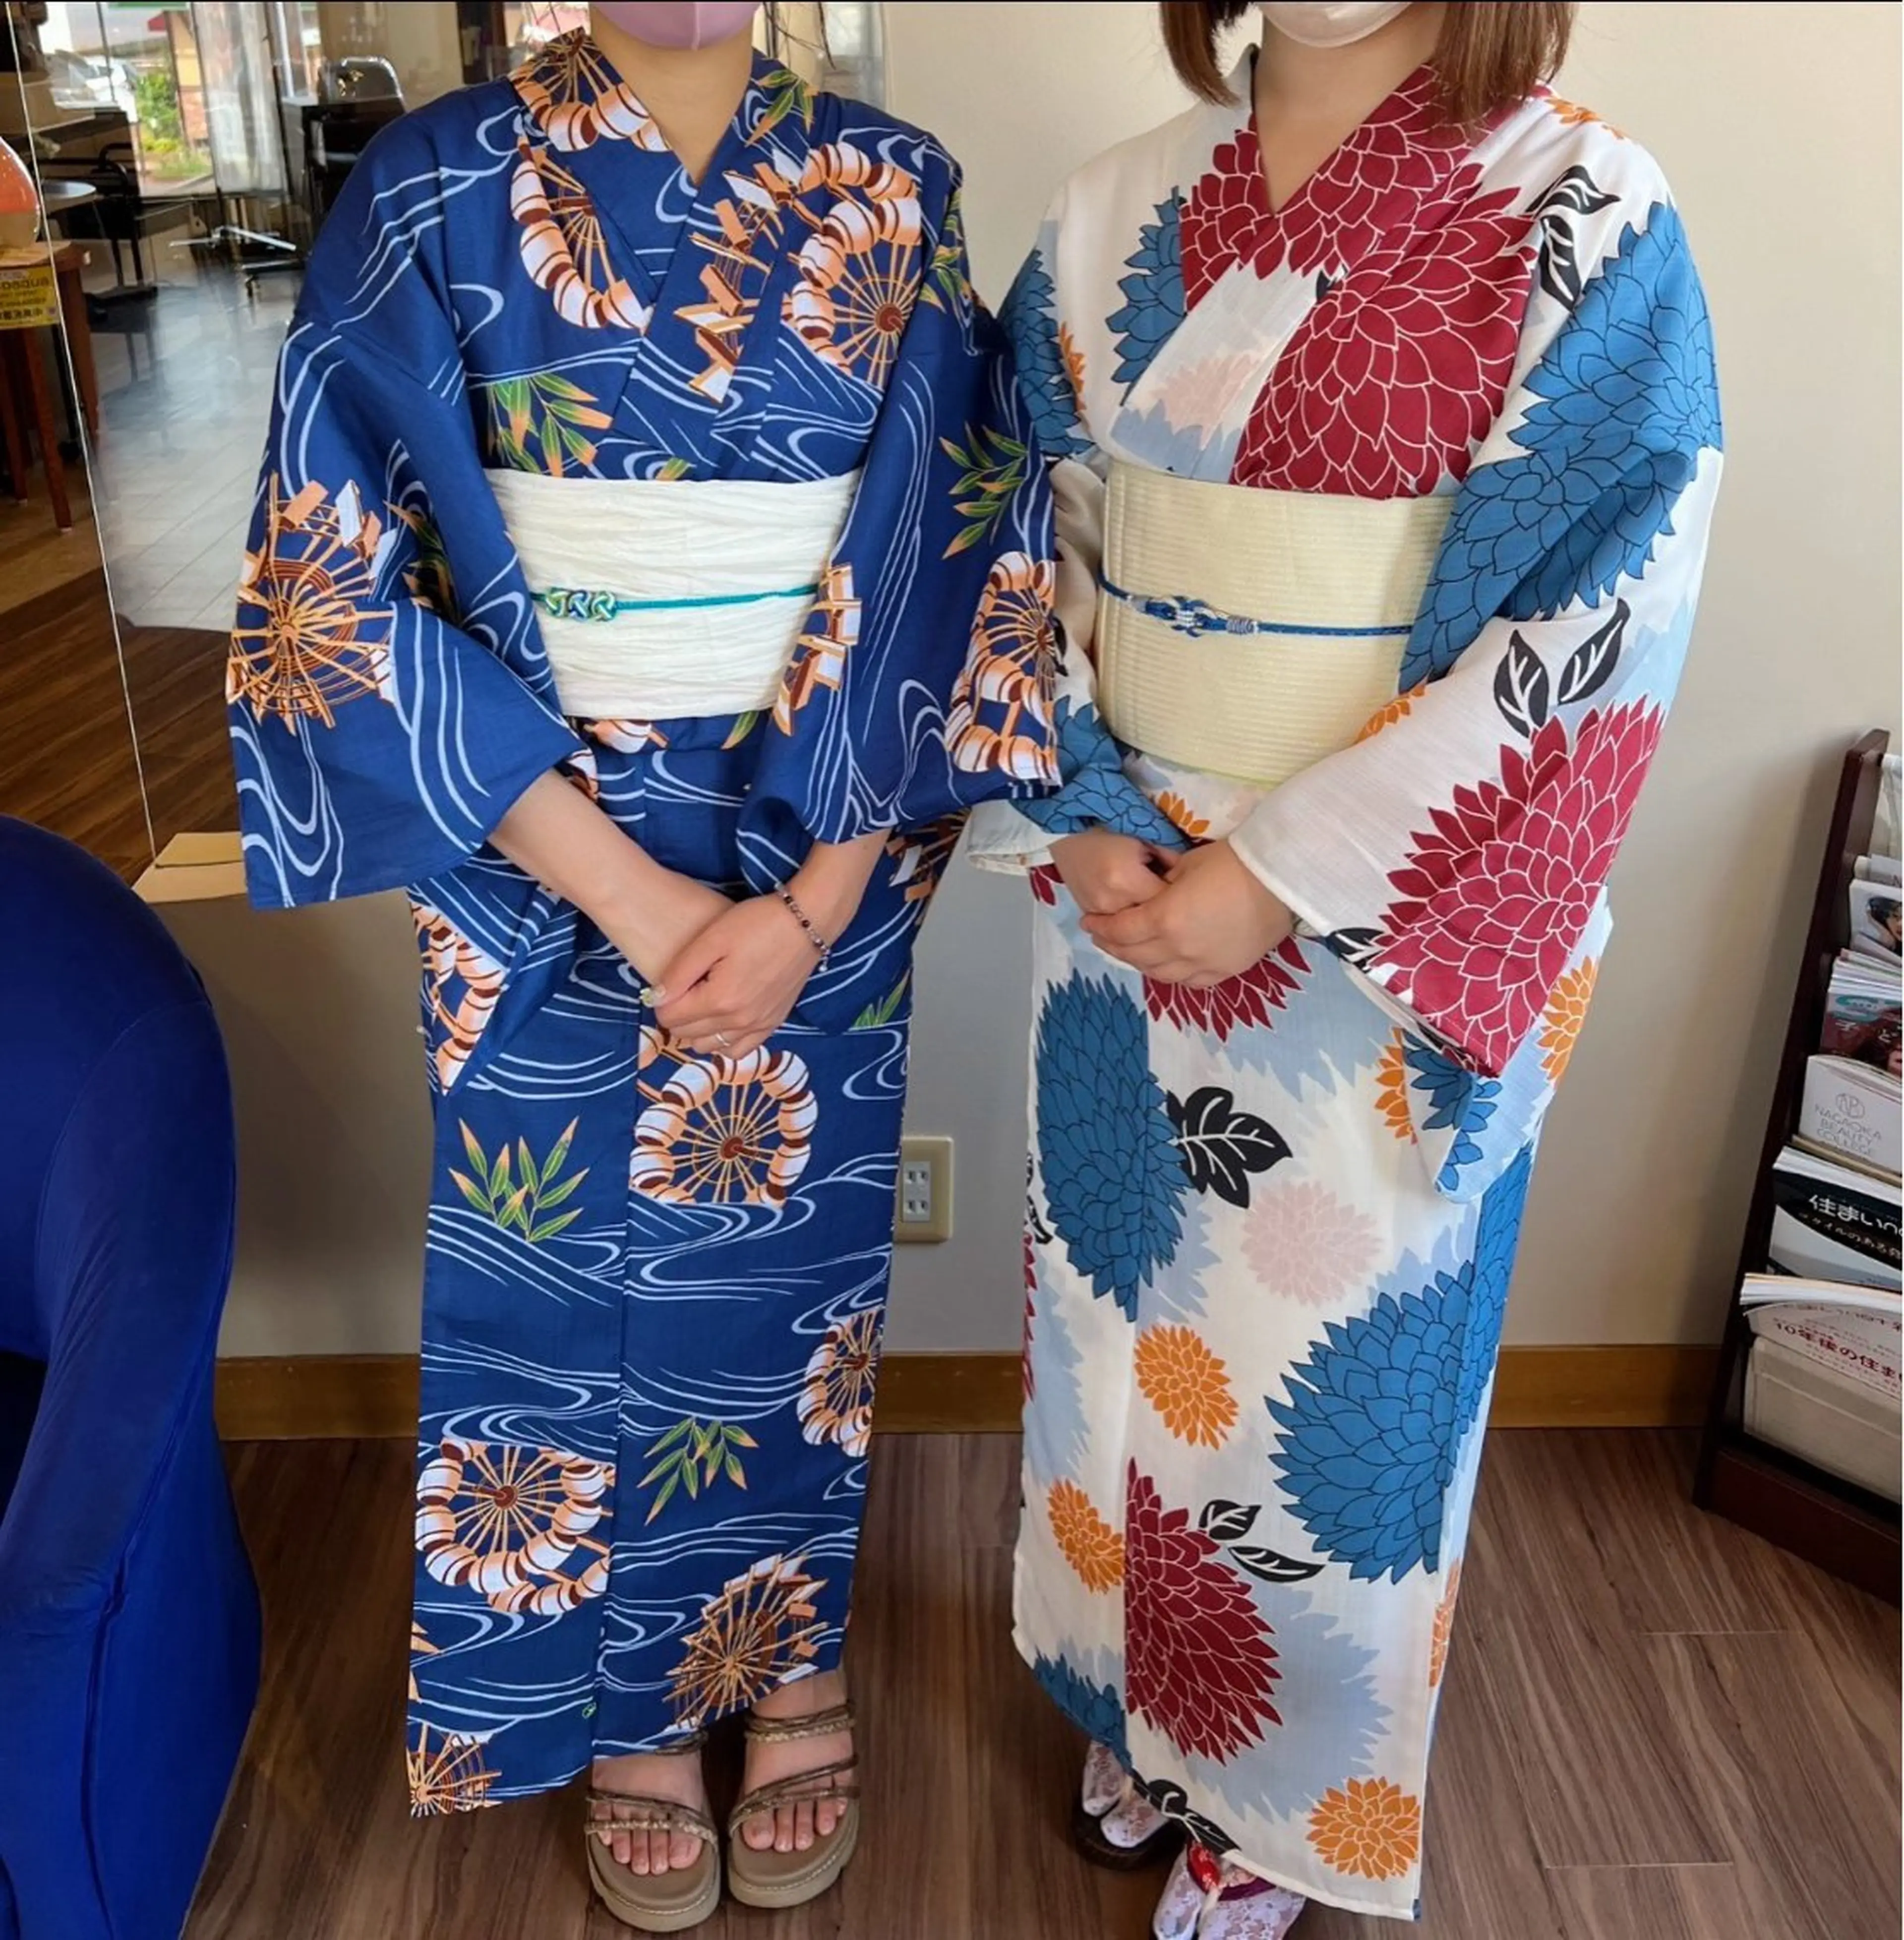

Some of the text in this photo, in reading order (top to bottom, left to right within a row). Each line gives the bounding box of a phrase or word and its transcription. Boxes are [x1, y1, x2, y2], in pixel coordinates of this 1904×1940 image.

[1815, 1103, 1882, 1140] NAGAOKA
[1821, 1118, 1873, 1146] BEAUTY
[1817, 1128, 1871, 1154] COLLEGE
